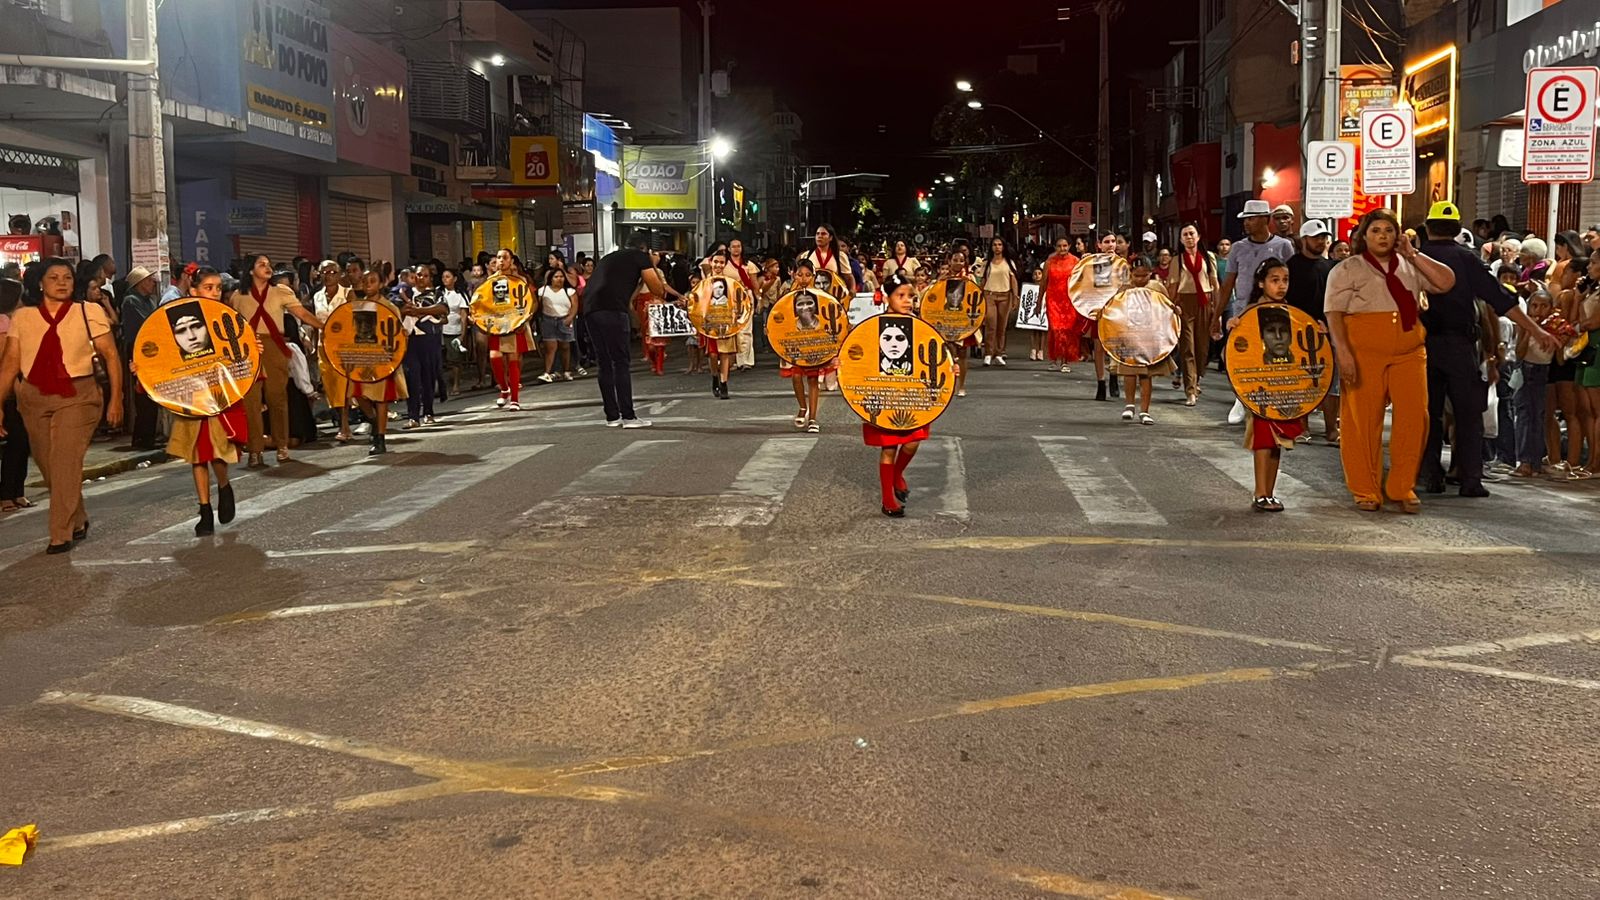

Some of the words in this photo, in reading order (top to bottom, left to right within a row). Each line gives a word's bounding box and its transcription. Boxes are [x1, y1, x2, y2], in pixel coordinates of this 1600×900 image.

[275, 5, 328, 53] FARMÁCIA
[278, 43, 296, 76] DO
[296, 51, 328, 87] POVO
[254, 91, 293, 113] BARATO
[1553, 87, 1570, 112] E
[1381, 122, 1393, 140] E
[527, 162, 545, 177] 20
[1326, 152, 1337, 169] E
[640, 182, 650, 190] DA
[652, 182, 684, 191] MODA
[630, 212, 657, 221] PREÇO
[659, 210, 685, 220] ÚNICO
